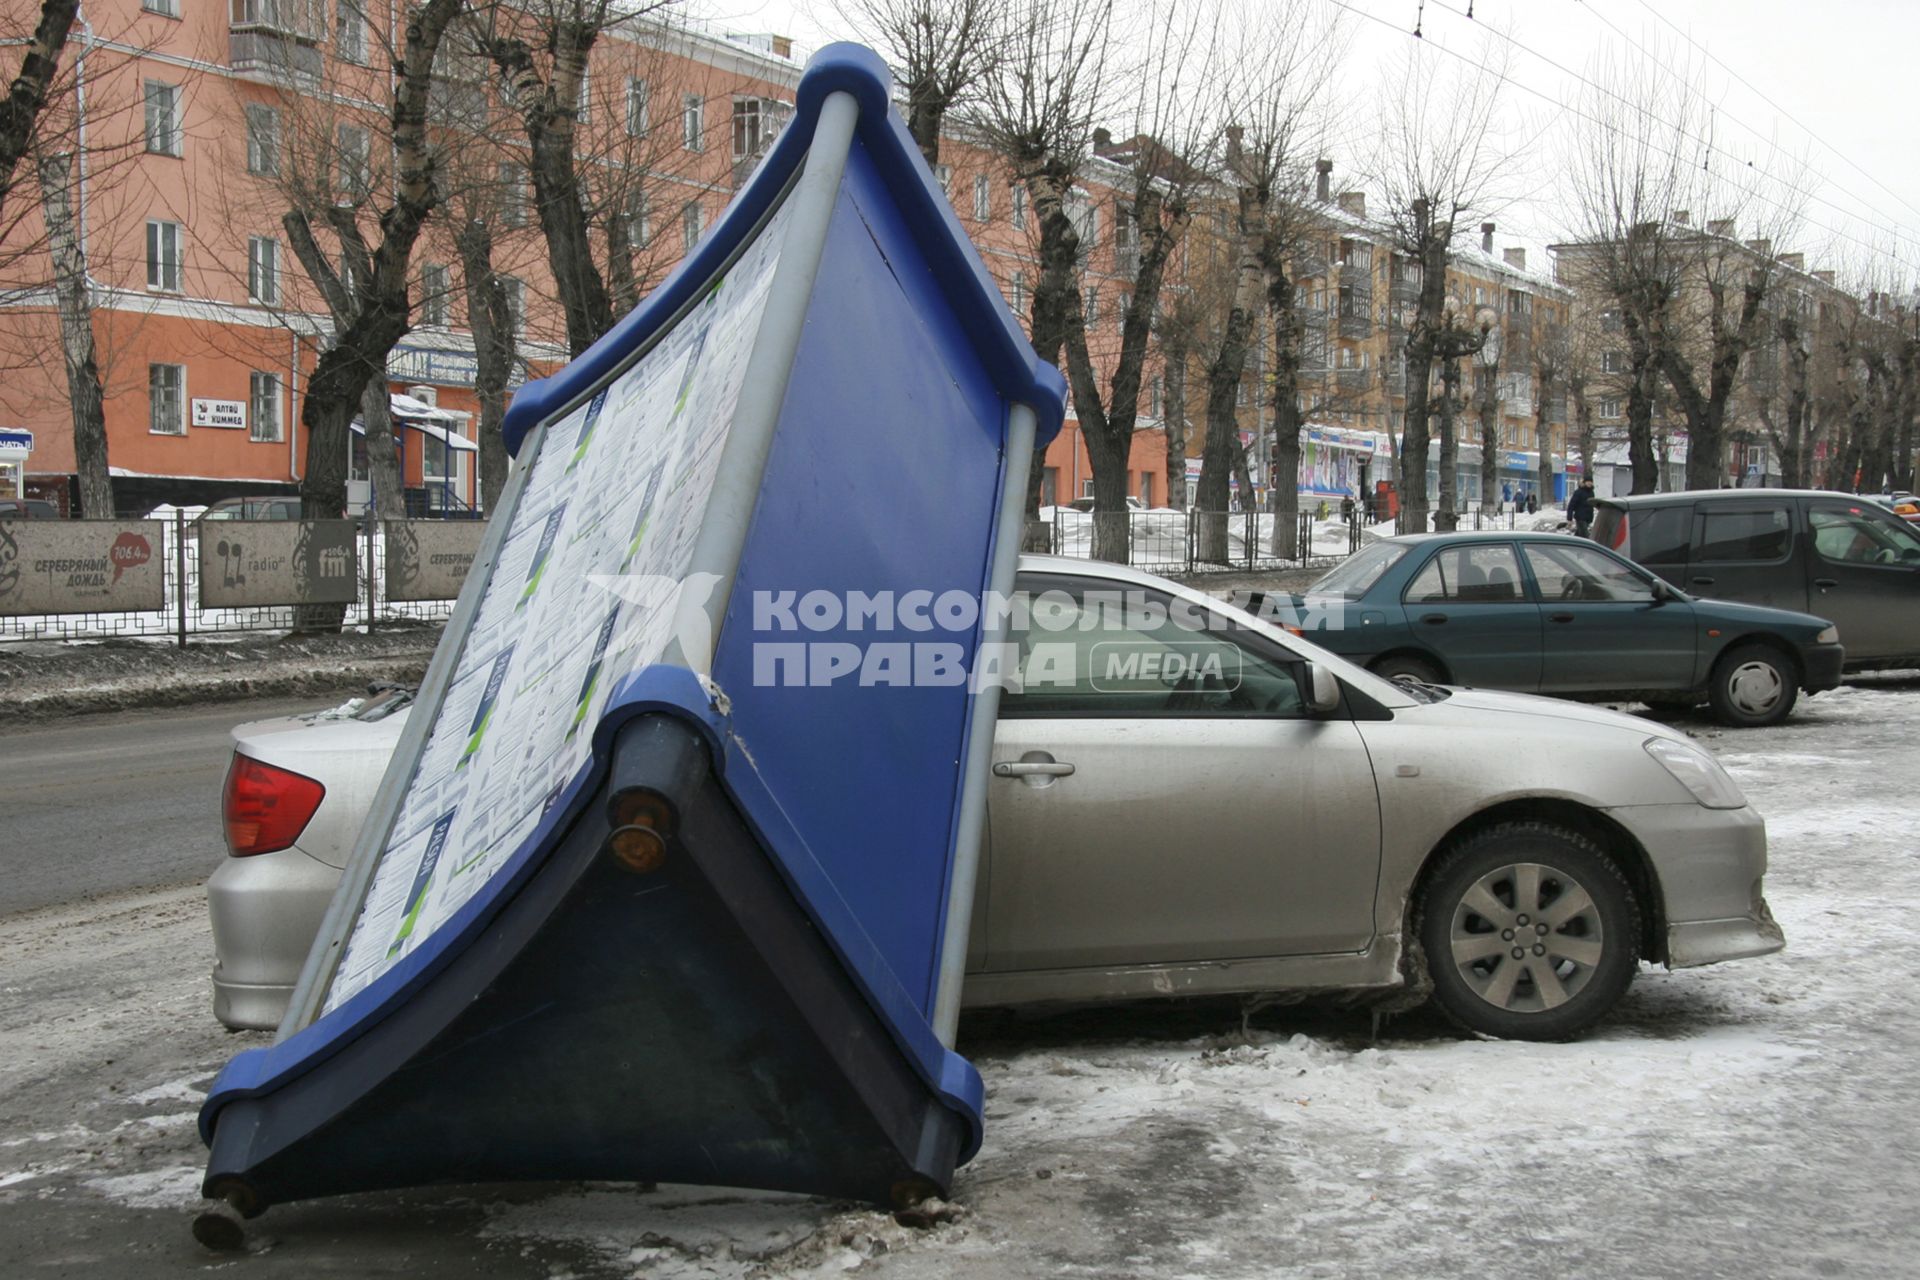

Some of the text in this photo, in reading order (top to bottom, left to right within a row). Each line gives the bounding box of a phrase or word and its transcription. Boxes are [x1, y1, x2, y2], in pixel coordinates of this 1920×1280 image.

[216, 403, 238, 413] АЛТАЙ
[211, 415, 242, 425] ХИММЕД
[35, 556, 108, 572] СЕРЕБРЯНЫЙ
[430, 553, 476, 565] СЕРЕБРЯНЫ
[66, 573, 106, 587] ДОЖДЬ
[419, 821, 449, 877] PALSUN
